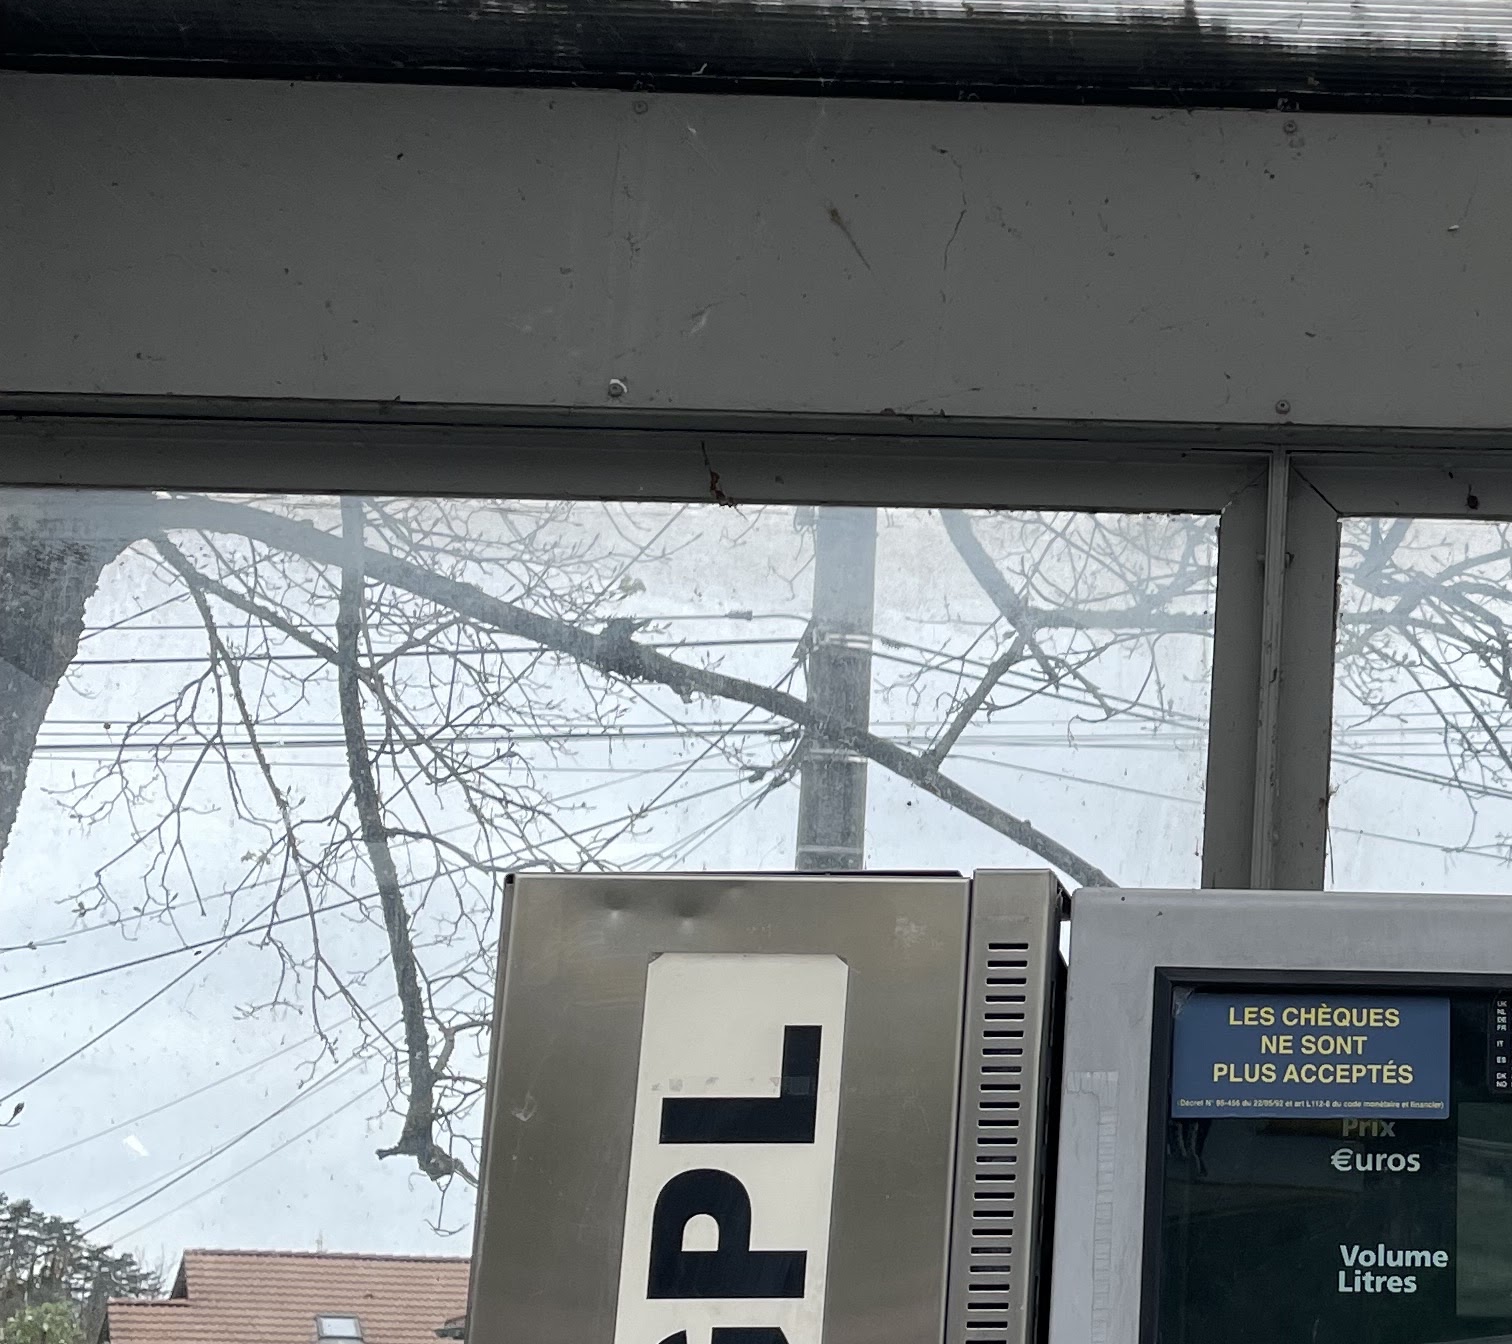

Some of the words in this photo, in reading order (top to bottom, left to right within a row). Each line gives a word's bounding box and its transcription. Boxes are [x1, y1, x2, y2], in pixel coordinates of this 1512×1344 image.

[1229, 1007, 1275, 1026] LES
[1282, 1003, 1400, 1027] CHÈQUES
[1260, 1035, 1294, 1054] NE
[1300, 1035, 1368, 1054] SONT
[1213, 1063, 1276, 1082] PLUS
[1282, 1060, 1414, 1084] ACCEPTÉS
[1330, 1148, 1420, 1173] €uros
[1339, 1244, 1449, 1268] Volume
[1338, 1270, 1418, 1294] Litres
